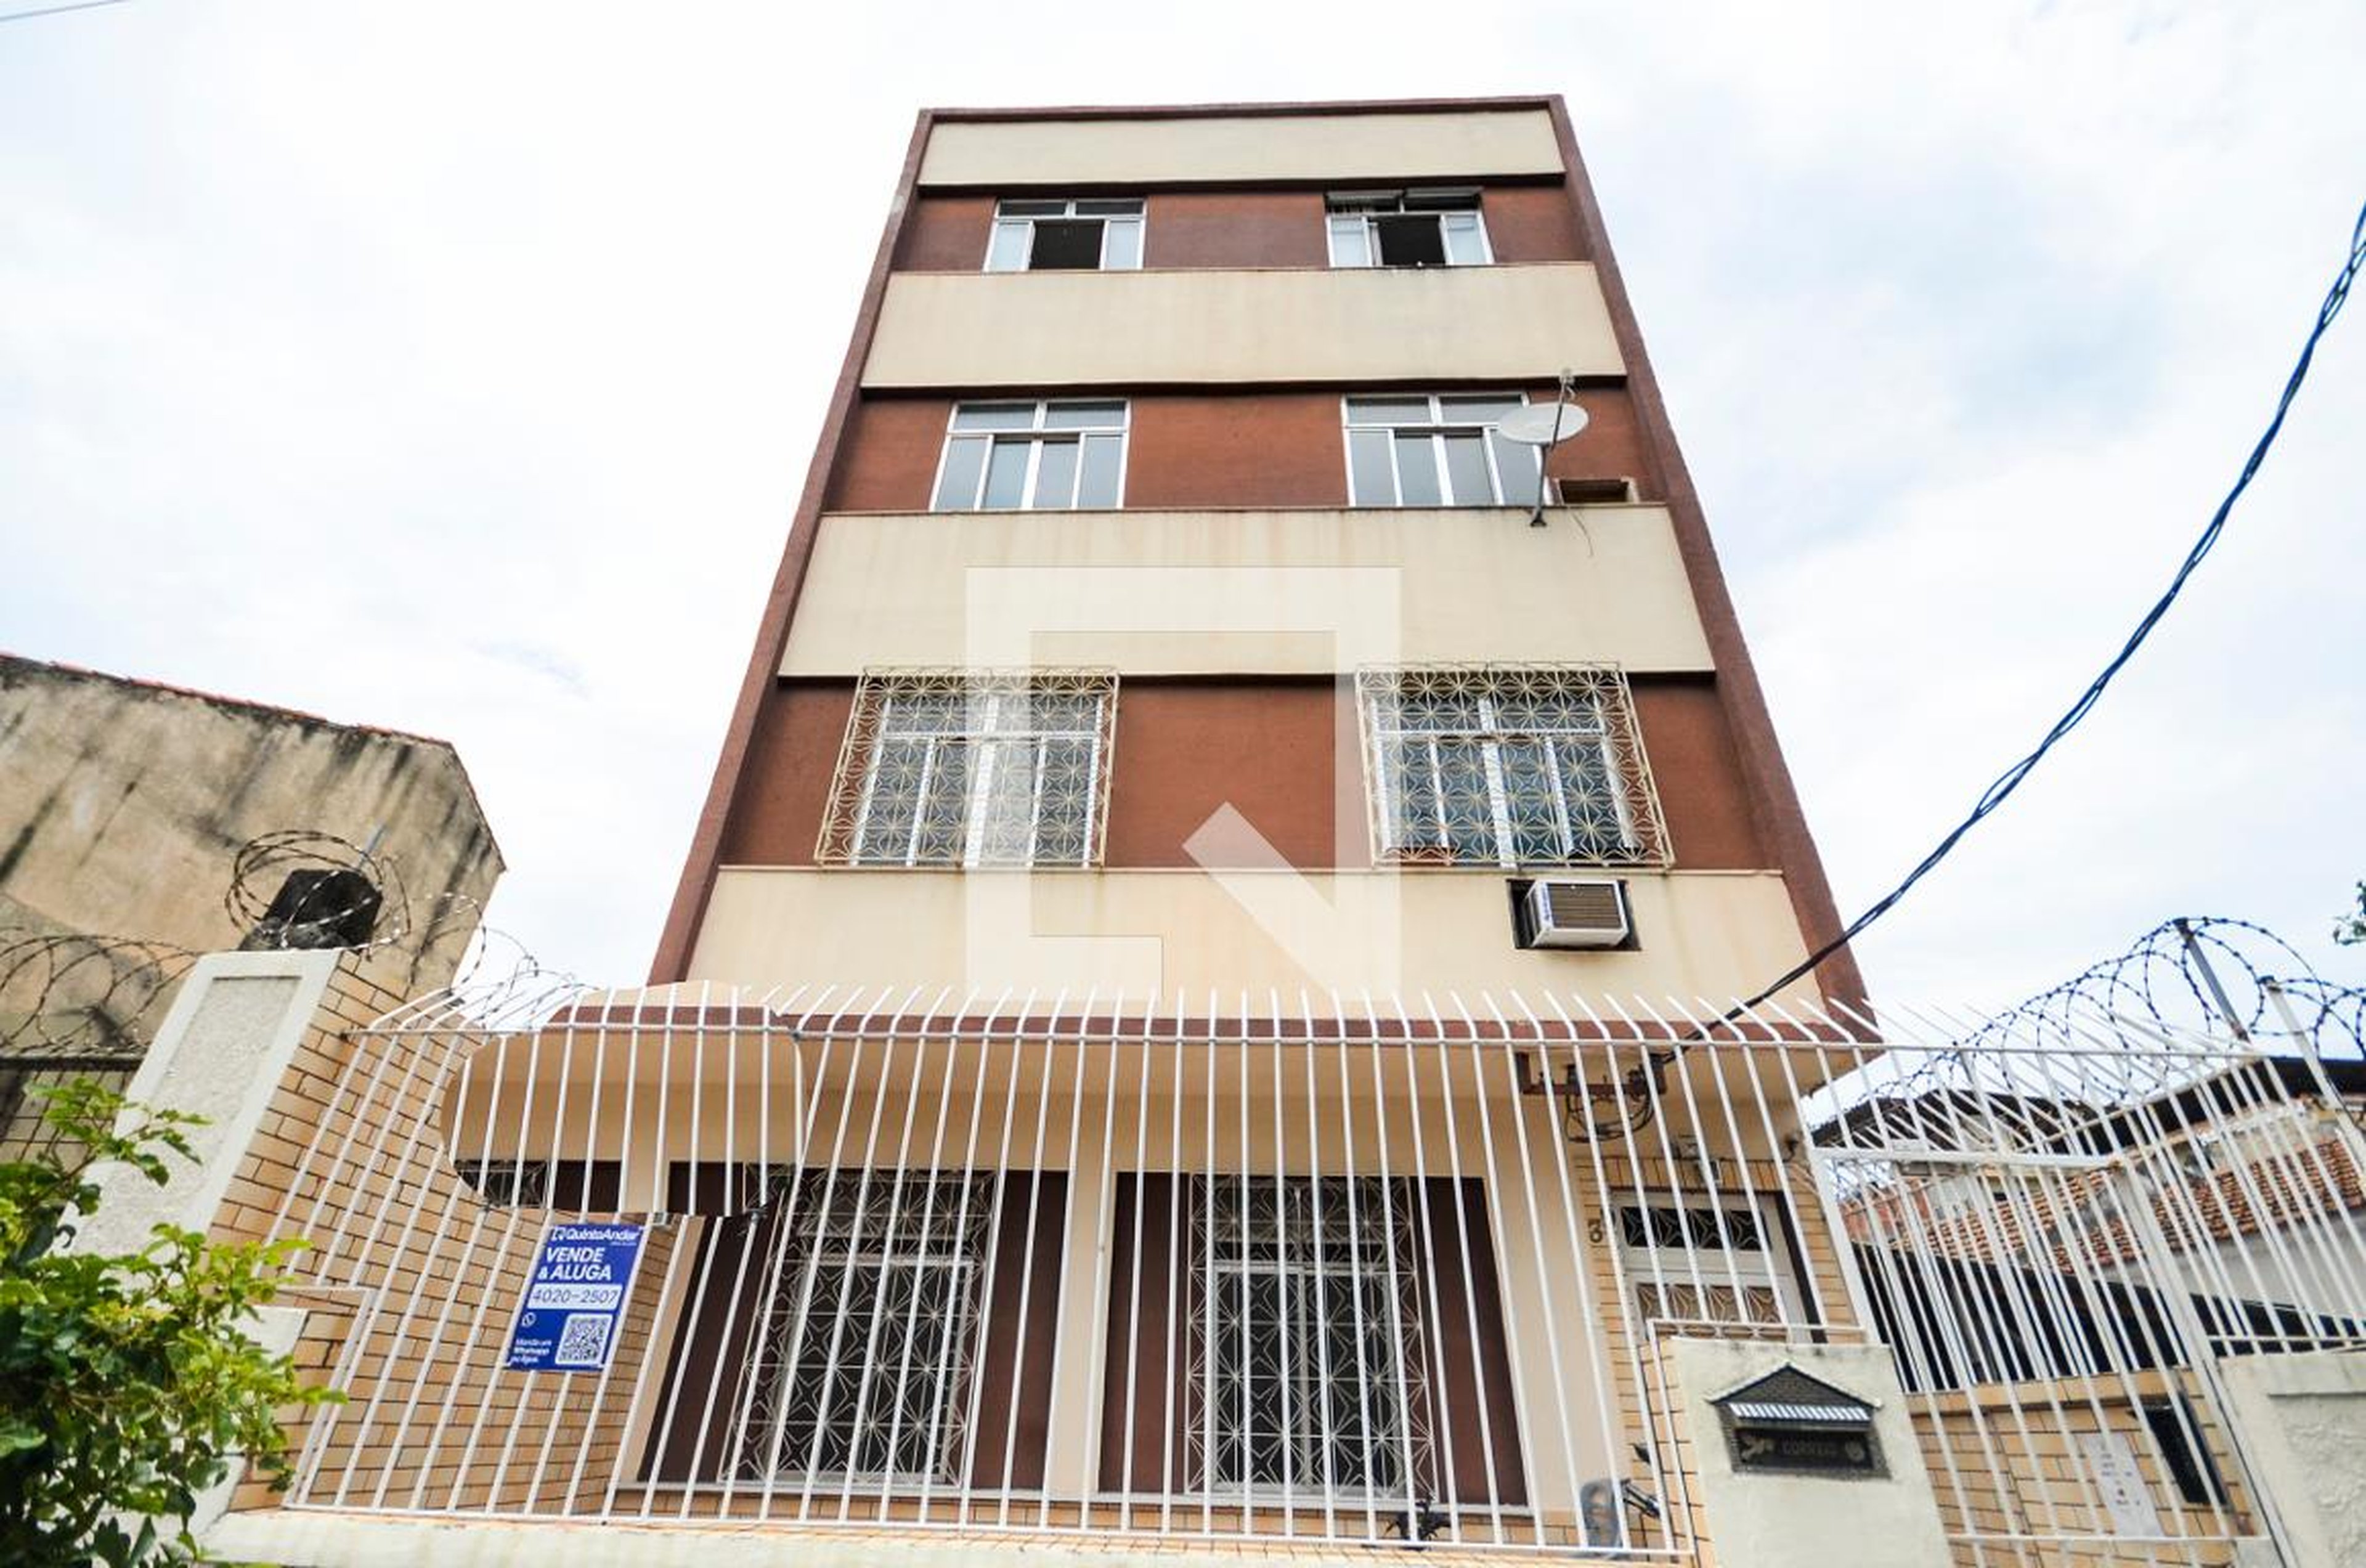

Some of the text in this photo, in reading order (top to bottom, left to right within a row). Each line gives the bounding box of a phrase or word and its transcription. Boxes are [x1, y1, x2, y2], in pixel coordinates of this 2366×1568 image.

[566, 1227, 639, 1241] QuintoAndar
[547, 1247, 605, 1262] VENDE
[537, 1264, 612, 1281] & ALUGA
[532, 1288, 618, 1304] 4020-2507
